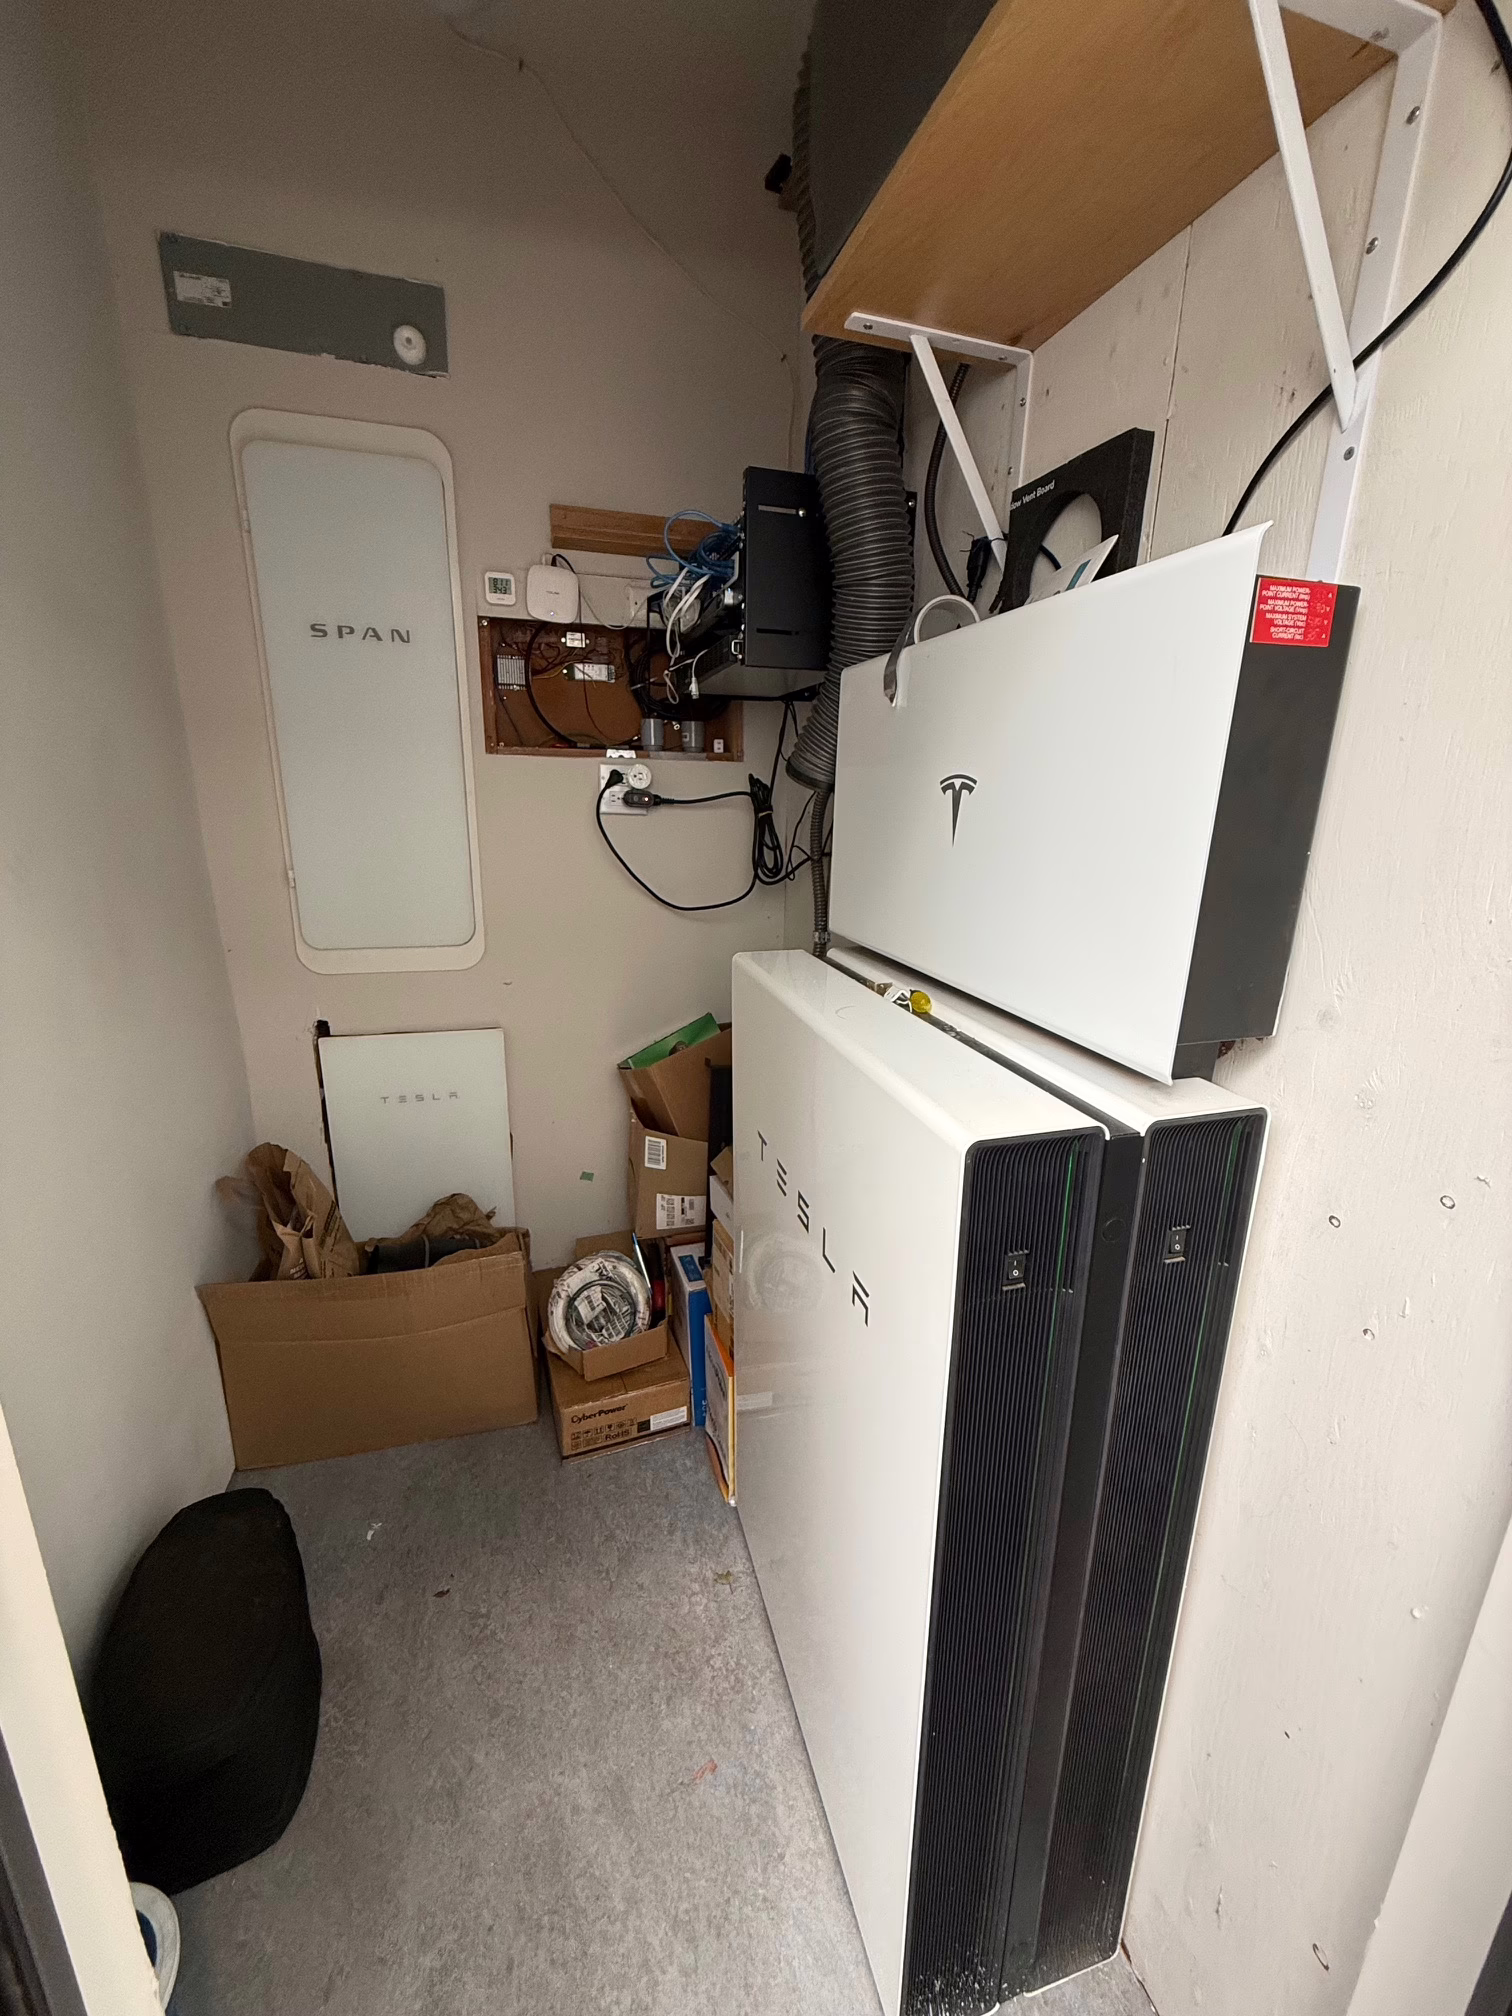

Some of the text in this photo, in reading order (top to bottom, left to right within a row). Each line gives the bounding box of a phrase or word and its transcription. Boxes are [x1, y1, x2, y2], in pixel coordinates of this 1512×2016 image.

[1022, 490, 1036, 504] Vent
[1037, 480, 1055, 497] Board
[309, 622, 411, 644] SPAN
[380, 1091, 458, 1104] TESLA
[757, 1130, 870, 1327] TESLA
[571, 1404, 627, 1424] CyberPower
[604, 1428, 631, 1441] RoHS
